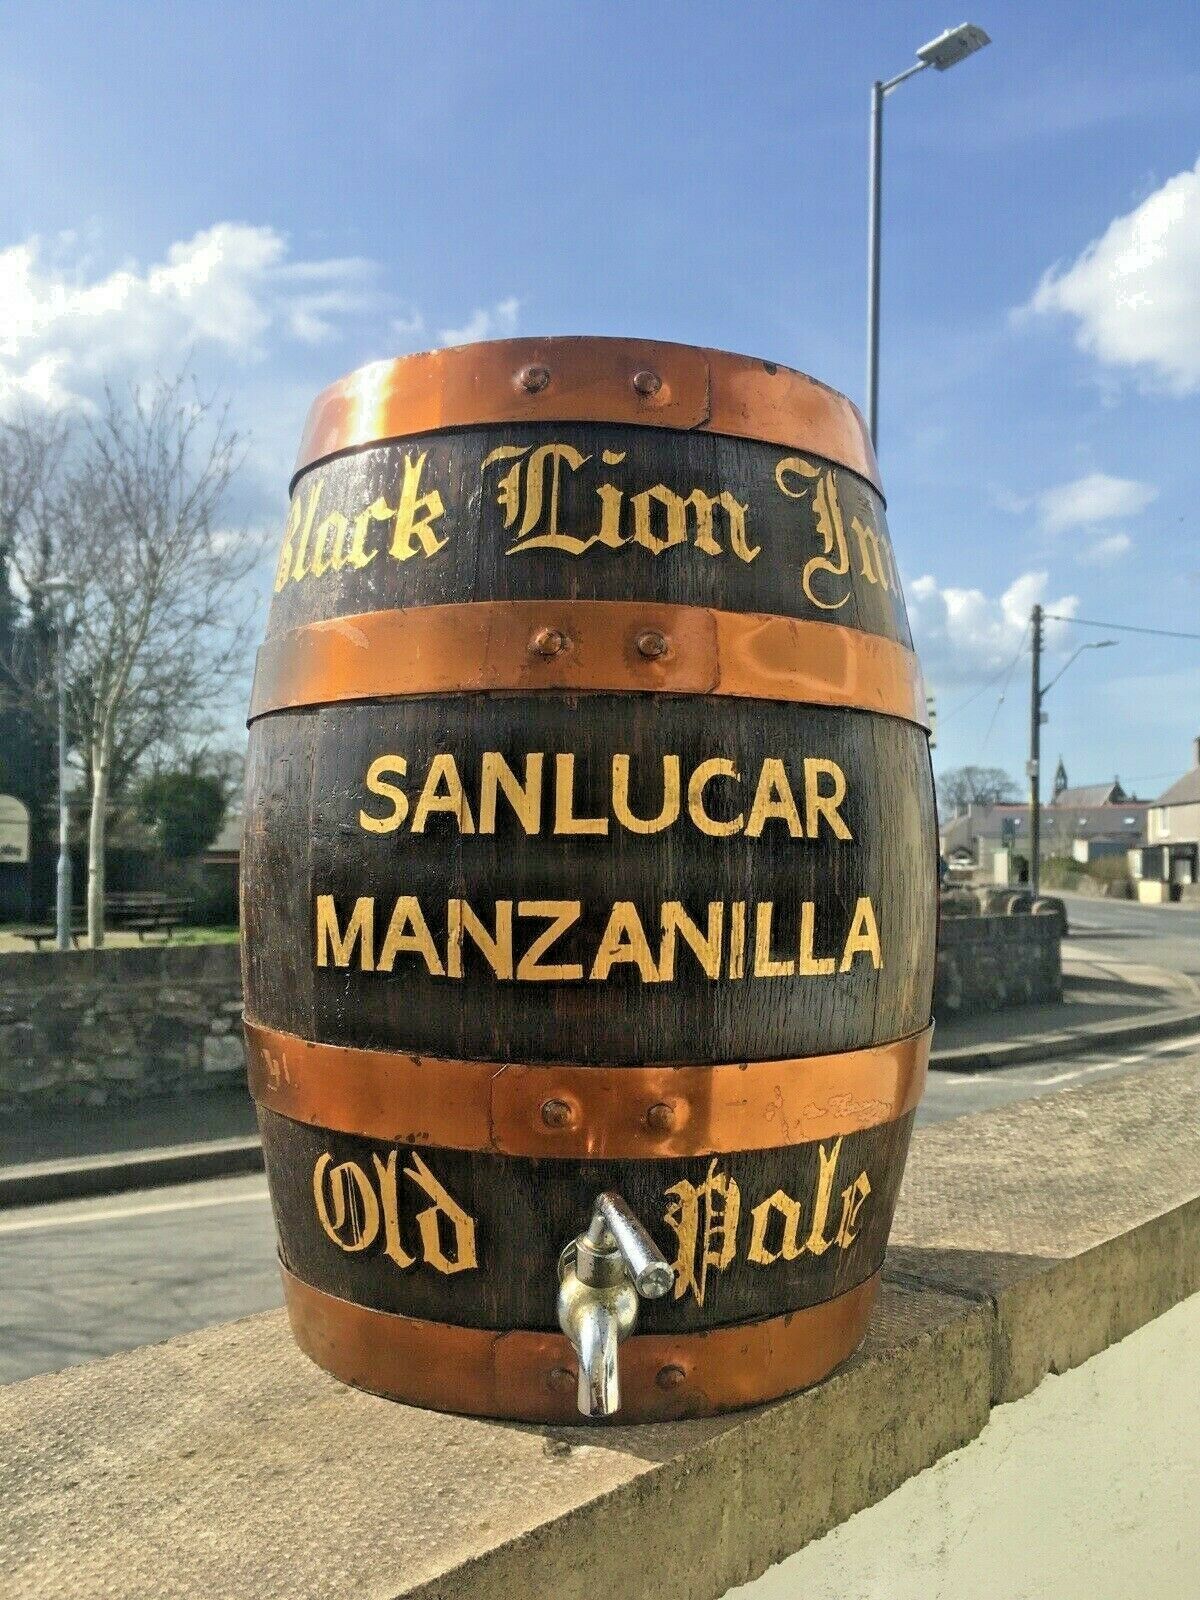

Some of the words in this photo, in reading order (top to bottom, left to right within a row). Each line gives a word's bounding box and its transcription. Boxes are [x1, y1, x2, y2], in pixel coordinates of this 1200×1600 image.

[480, 443, 762, 563] Lion
[359, 751, 853, 840] SANLUCAR
[315, 894, 883, 983] MANZANILLA
[312, 1149, 480, 1276] Old
[662, 1137, 874, 1308] Pale
